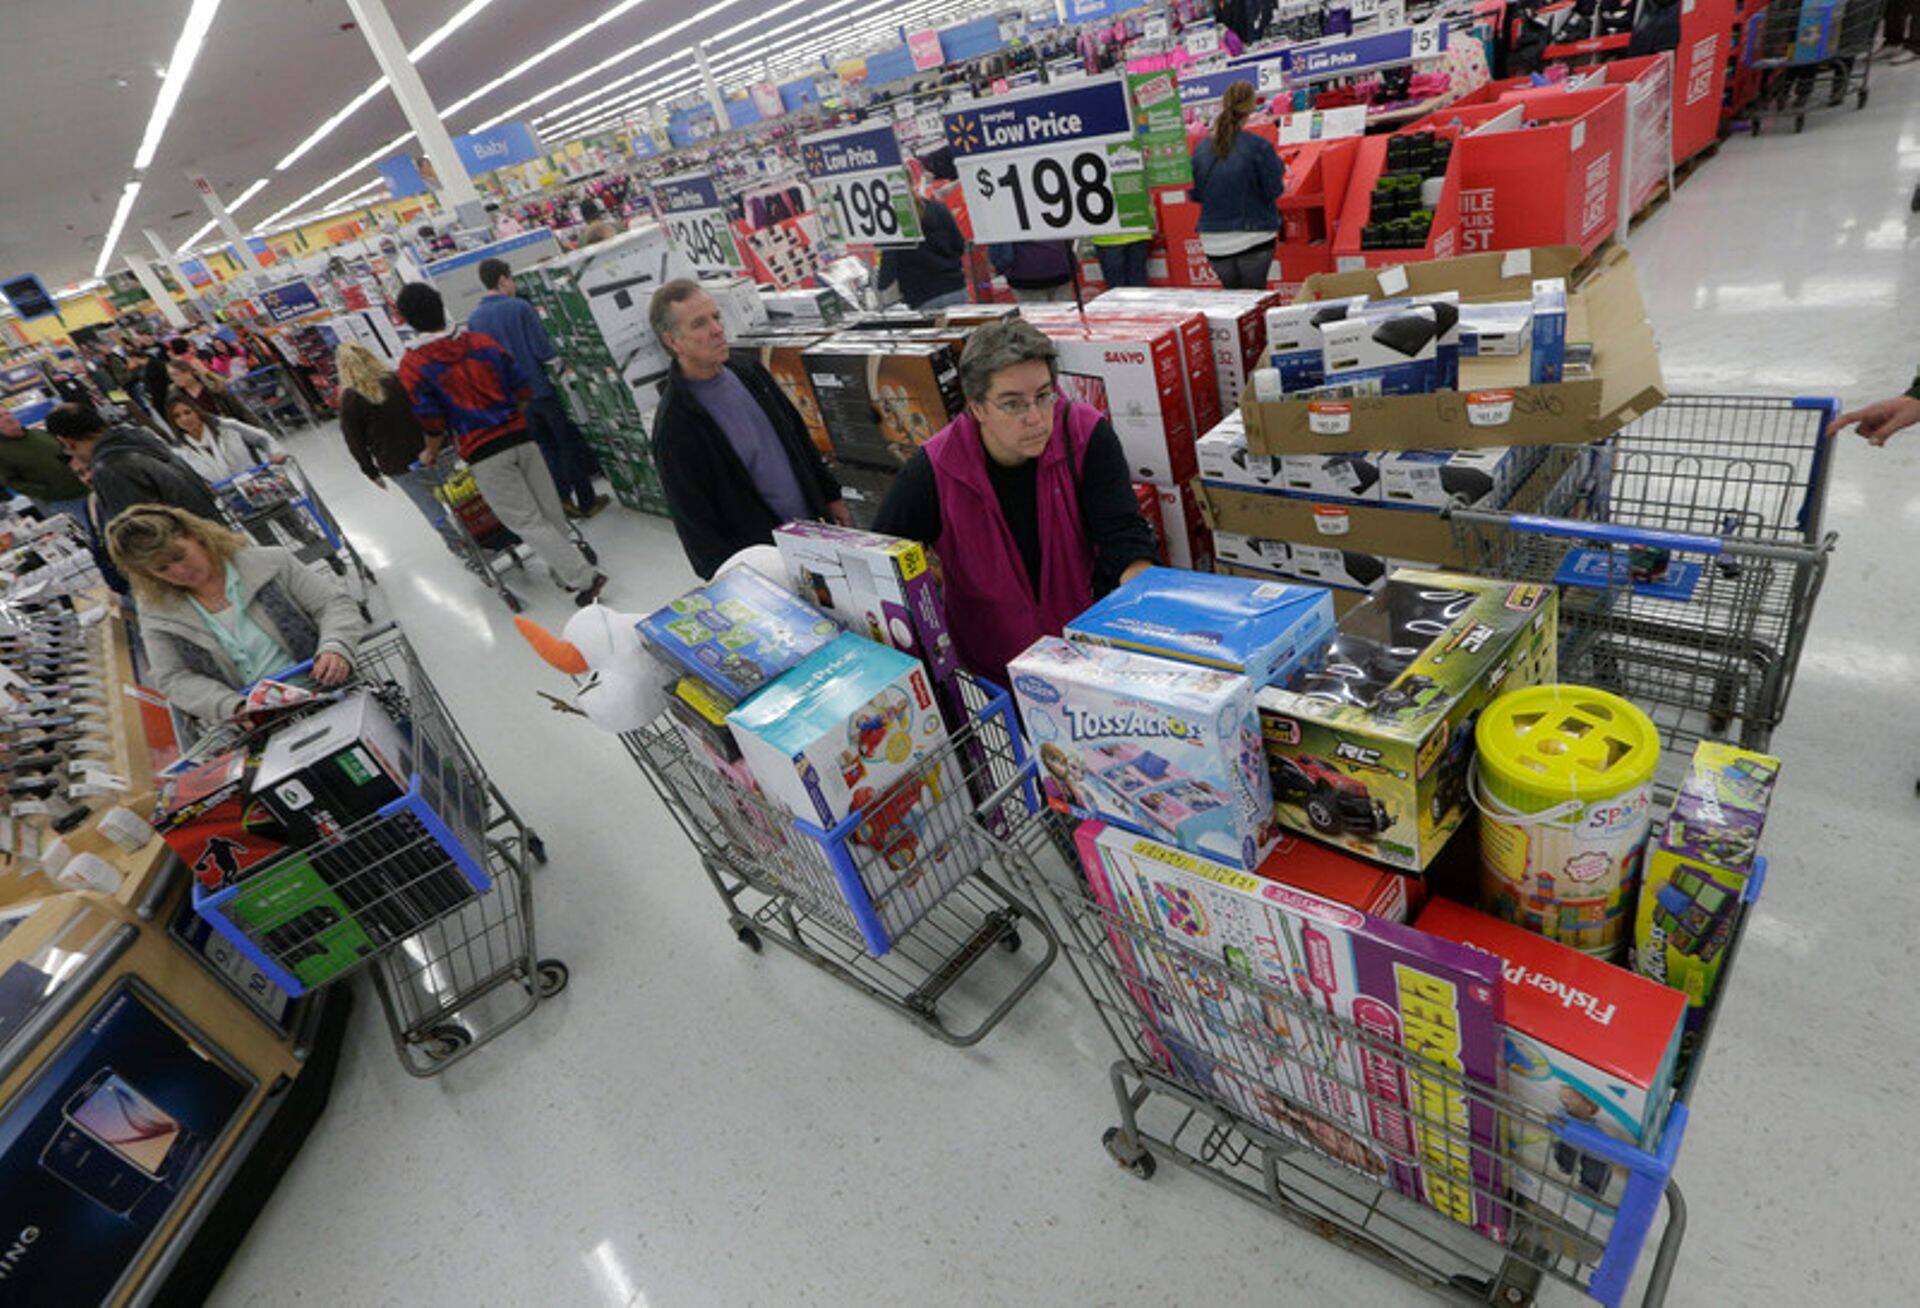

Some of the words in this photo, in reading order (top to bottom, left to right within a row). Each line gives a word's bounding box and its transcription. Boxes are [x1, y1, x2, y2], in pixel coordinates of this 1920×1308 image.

[982, 122, 1025, 147] Low
[1026, 111, 1083, 140] Price
[823, 153, 848, 171] Low
[846, 144, 879, 168] Price
[833, 178, 898, 237] 198
[1104, 351, 1144, 365] SANYO
[1336, 742, 1383, 765] RC
